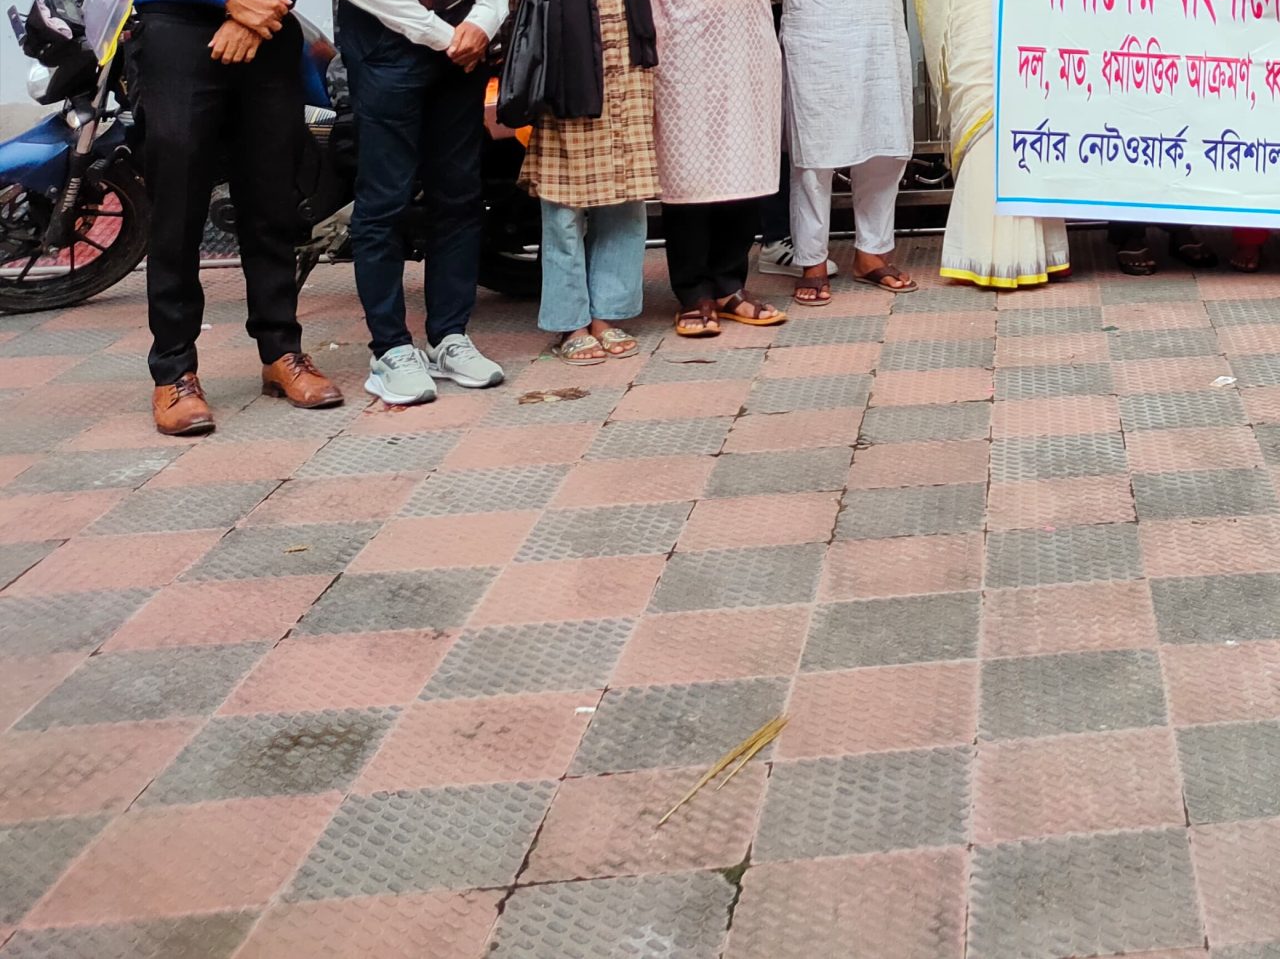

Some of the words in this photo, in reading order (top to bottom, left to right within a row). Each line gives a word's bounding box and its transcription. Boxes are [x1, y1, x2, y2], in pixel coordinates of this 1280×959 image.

[1017, 45, 1051, 100] দল,
[1058, 47, 1093, 101] মত,
[1101, 34, 1182, 96] ধর্মভিত্তিক
[1184, 49, 1256, 110] আক্রমণ,
[1011, 118, 1071, 174] দূর্বার
[1078, 122, 1192, 177] নেটওয়ার্ক,
